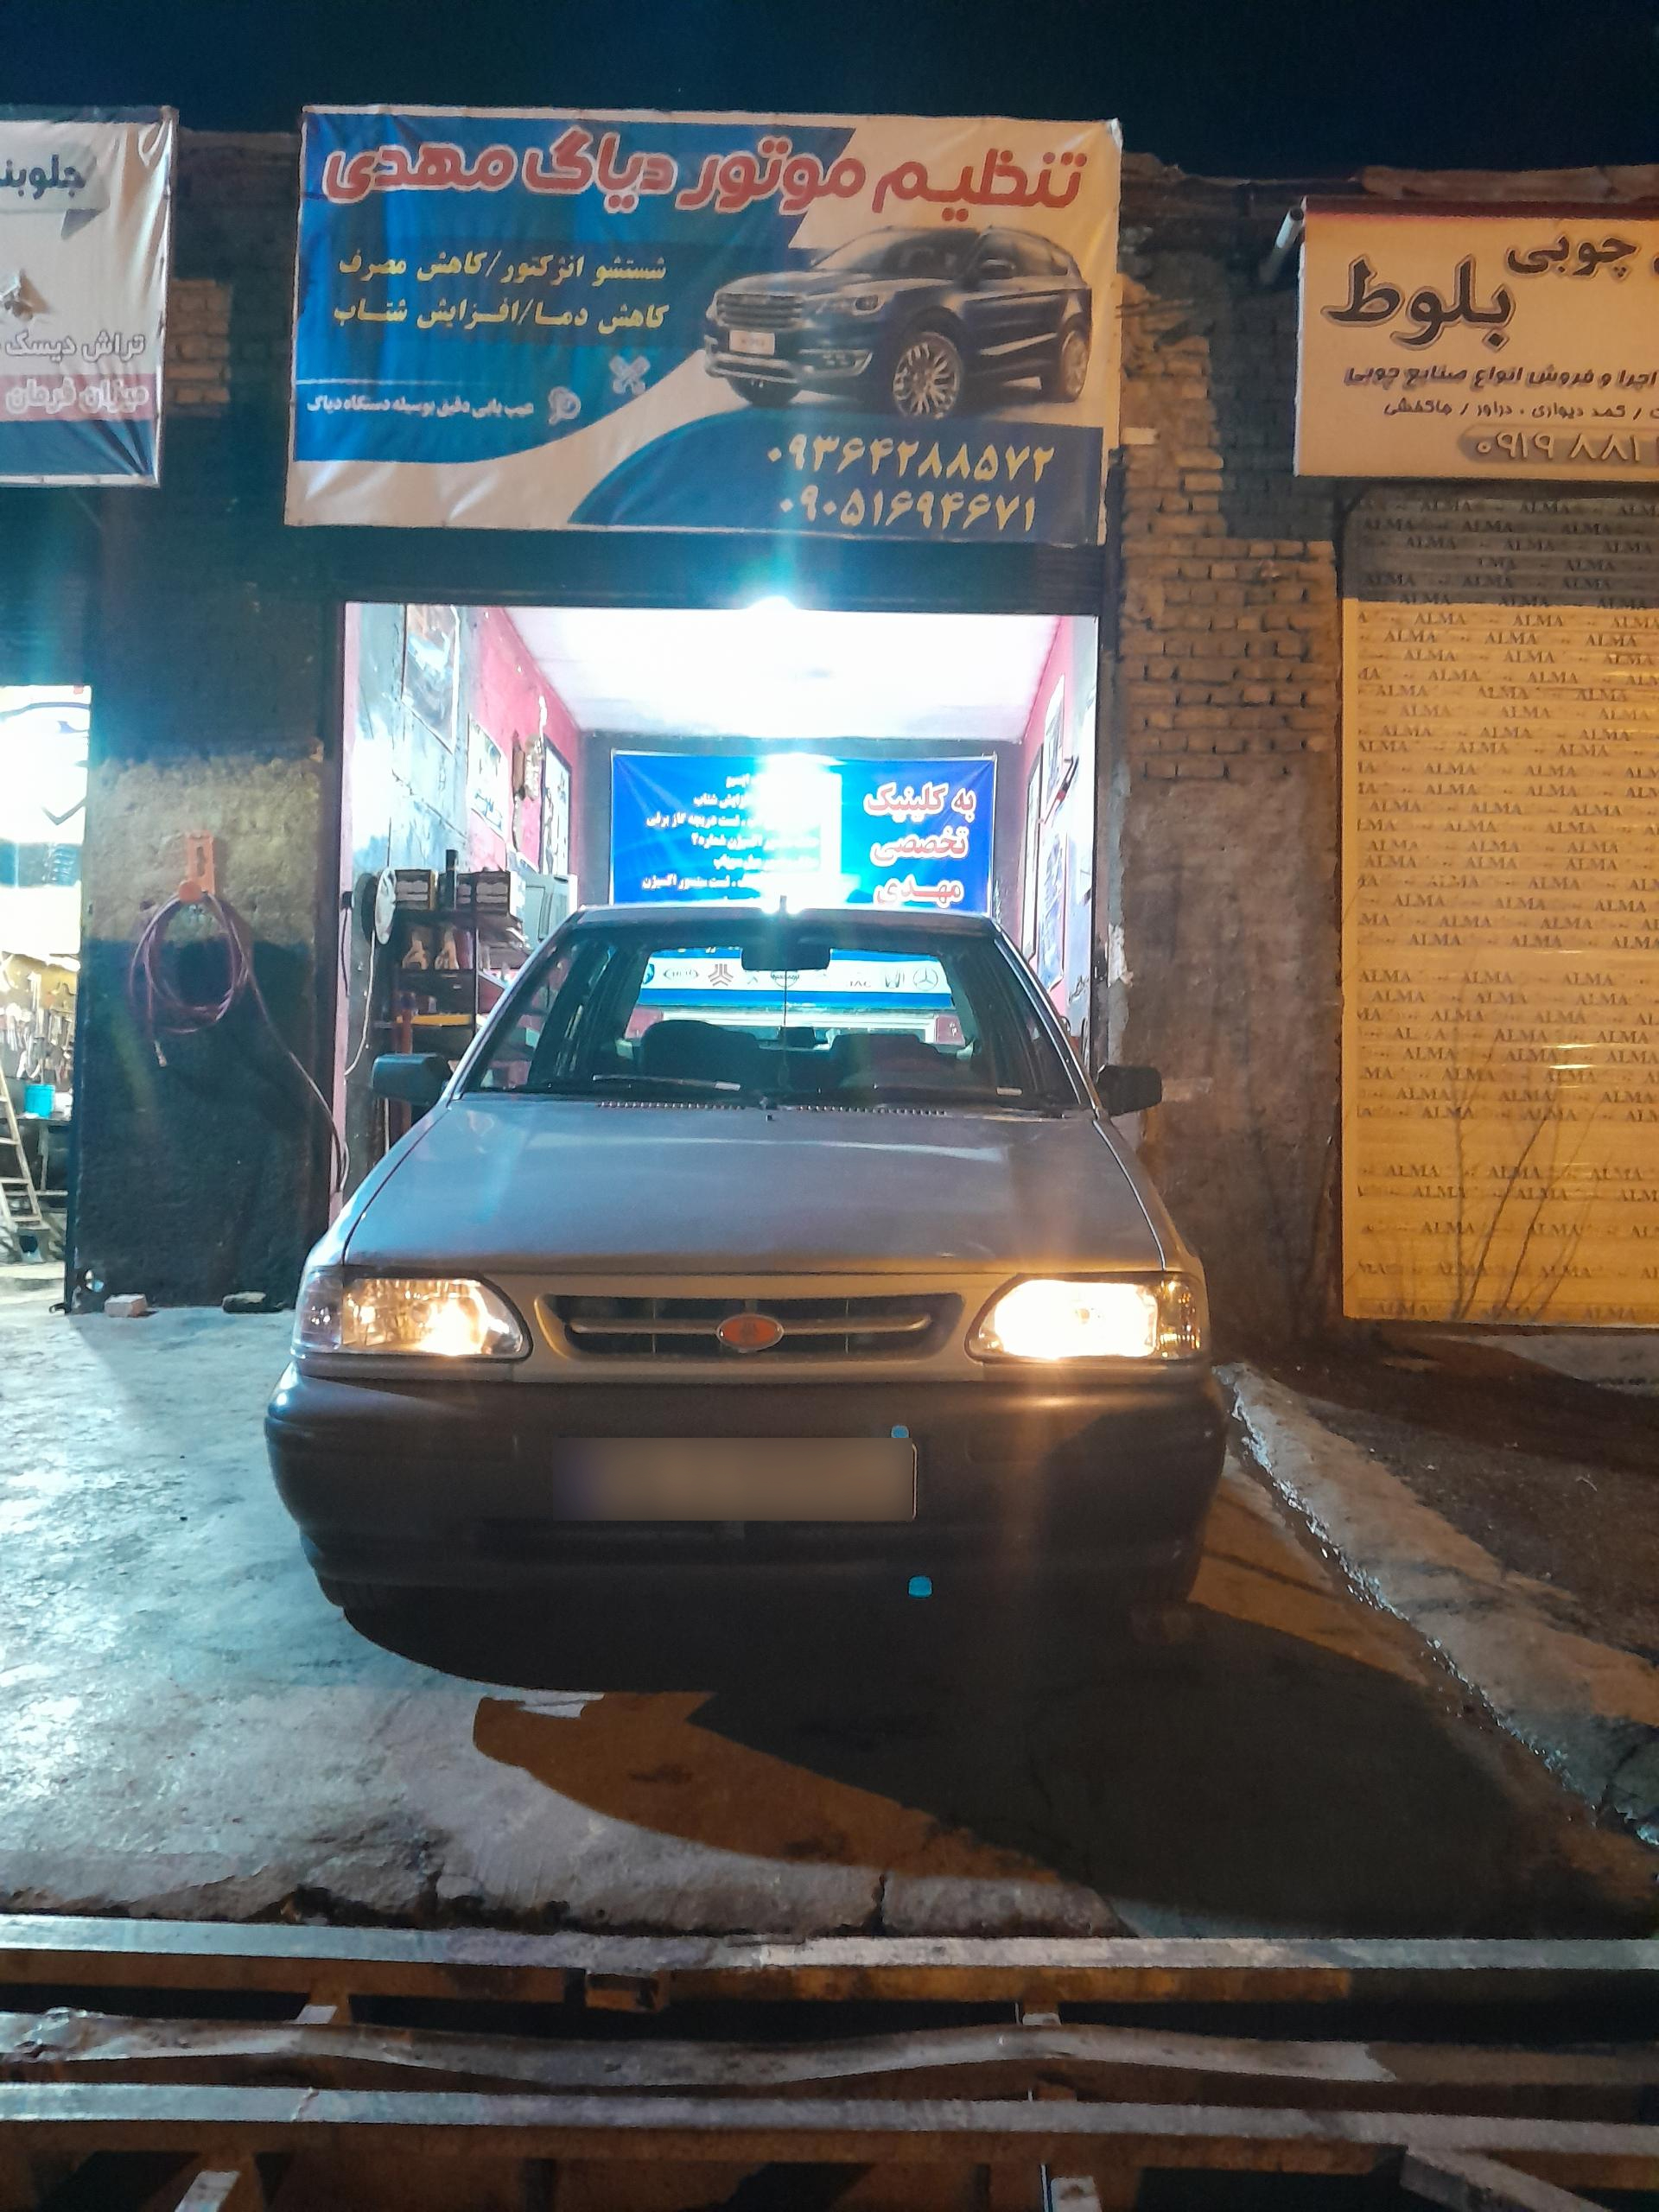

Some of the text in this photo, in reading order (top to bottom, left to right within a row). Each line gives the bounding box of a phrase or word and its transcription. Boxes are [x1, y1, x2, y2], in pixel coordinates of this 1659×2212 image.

[321, 144, 518, 204] مهدی
[677, 136, 866, 215] موتور
[871, 148, 1088, 222] تنظیم
[1507, 234, 1637, 277] چوبی
[340, 249, 406, 282] مصرف
[592, 256, 666, 287] شستشو
[1322, 256, 1516, 351] بلوط
[334, 298, 407, 327] شتاب
[598, 303, 670, 334] کاهش
[5, 329, 145, 363] تراش دیسک
[1344, 364, 1657, 391] اجرا و فروش انواع صنایع چوبی
[1591, 404, 1625, 417] کمد
[1476, 432, 1641, 462] ۰۹۱۹ ۸۸۱
[767, 433, 1055, 483] ۰۹۳۶۴۲۸۸۵۷۲
[780, 484, 1036, 532] ۰۹۰۵۱۶۹۴۶۷۱
[1617, 505, 1659, 518] ALM
[1363, 518, 1611, 535] ALMA ALMA ALMA
[1405, 536, 1653, 554] ALMA ALMA ALMA
[1563, 558, 1615, 571] ALMA
[1363, 573, 1612, 590] ALMA ALMA ALMA
[1399, 591, 1451, 604] ALMA
[1414, 613, 1466, 626] ALMA
[1512, 614, 1564, 627] ALMA
[1385, 630, 1637, 647] ALMA ALMA ALMA
[1404, 649, 1456, 662] ALMA
[1503, 651, 1555, 664] ALMA
[1428, 669, 1659, 687] ALMA ALMA ALM
[1376, 684, 1427, 697] ALMA
[1476, 686, 1528, 699] ALMA
[1399, 704, 1649, 721] ALMA ALMA ALMA
[1380, 725, 1630, 741] ALMA ALMA ALMA
[1457, 742, 1509, 755] ALMA
[1556, 744, 1608, 757] ALMA
[1424, 763, 1659, 779] ALMA ALMA ALM
[1425, 783, 1659, 799] ALMA ALMA ALM
[862, 781, 976, 823] به کلینیک
[1370, 800, 1622, 817] ALMA ALMA ALMA
[1445, 820, 1597, 835] ALMA ALMA
[869, 825, 969, 868] تخصصی
[1368, 839, 1619, 854] ALMA ALMA ALMA
[1364, 855, 1618, 871] ALMA ALMA ALMA
[873, 874, 964, 908] مهدی
[1427, 875, 1580, 890] ALMA ALMA
[1393, 894, 1646, 912] ALMA ALMA ALMA
[1440, 915, 1592, 930] ALMA ALMA
[1409, 933, 1461, 946] ALMA
[1510, 935, 1562, 948] ALMA
[1359, 970, 1613, 986] ALMA ALMA ALMA
[1373, 990, 1628, 1006] ALMA ALMA ALMA
[1432, 1009, 1586, 1024] ALMA ALMA
[1495, 1029, 1649, 1043] ALMA ALMA
[1403, 1047, 1658, 1064] ALMA ALMA ALMA
[1442, 1068, 1494, 1081] ALMA
[1397, 1088, 1653, 1103] ALMA ALMA ALMA
[1421, 1106, 1473, 1119] ALMA
[1625, 1110, 1659, 1123] ALM
[1387, 1165, 1439, 1178] ALMA
[1414, 1185, 1659, 1203] ALMA ALMA ALM
[1584, 1306, 1636, 1319] ALMA
